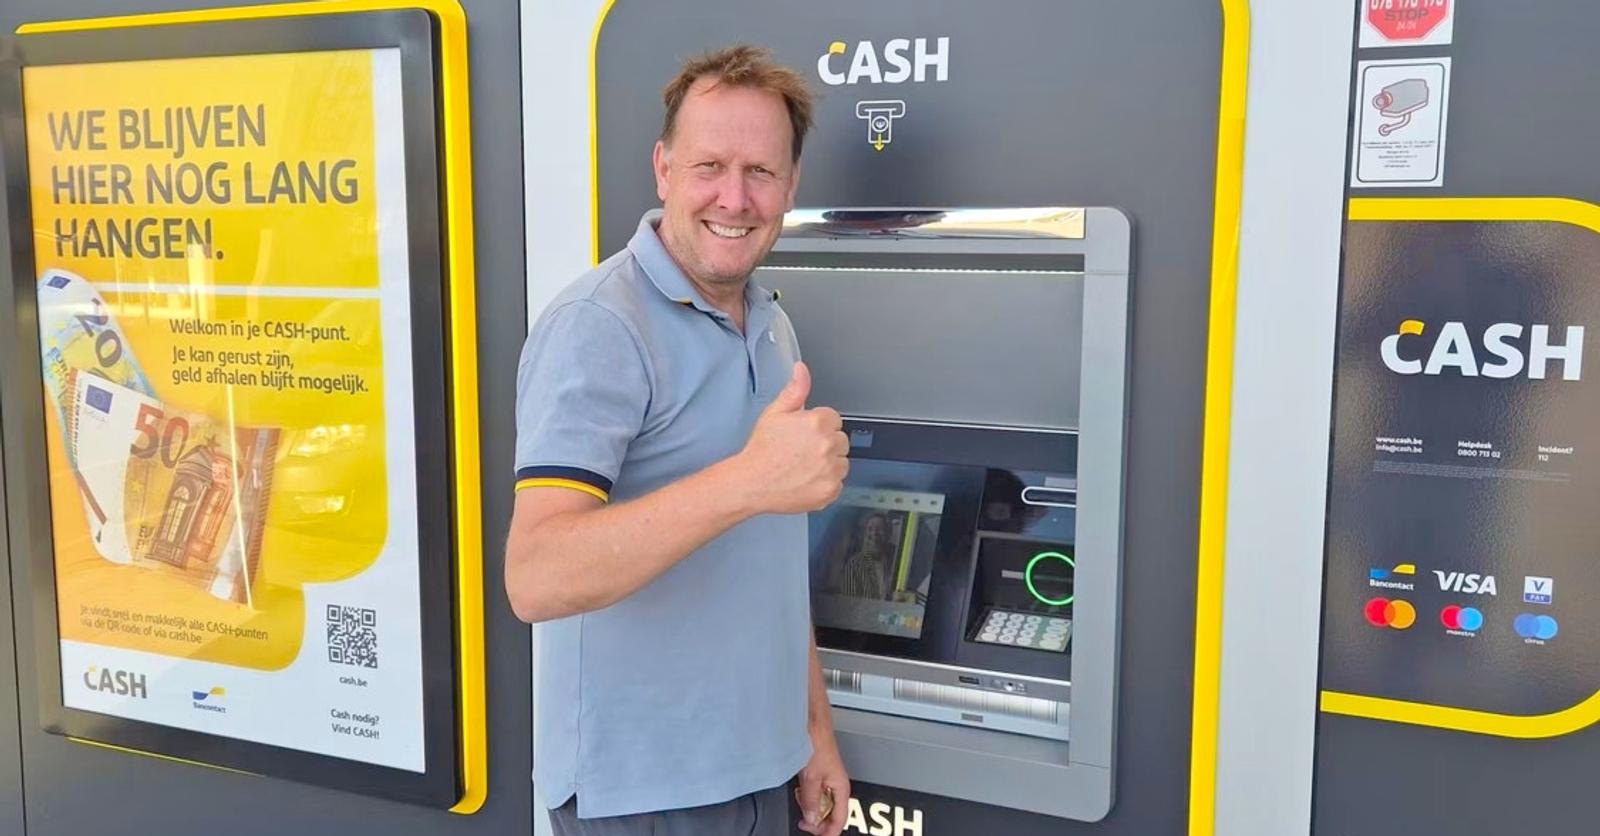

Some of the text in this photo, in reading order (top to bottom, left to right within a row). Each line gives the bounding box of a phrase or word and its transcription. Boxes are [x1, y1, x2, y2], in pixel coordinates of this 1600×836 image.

[1385, 8, 1429, 20] STOP
[817, 37, 950, 85] CASH
[48, 104, 266, 159] WE BLIJVEN
[52, 159, 359, 205] HIER NOG LANG
[54, 217, 224, 261] HANGEN.
[170, 319, 350, 343] Welkom in je CASH-punt.
[173, 345, 294, 371] Je kan gerust zijn,
[1380, 319, 1585, 381] CASH
[172, 367, 369, 395] geld afhalen blijft mogelijk.
[130, 402, 190, 469] 50
[1375, 437, 1423, 446] www.cash.be
[1458, 441, 1492, 450] Helpdesk
[1375, 444, 1423, 454] info@cash.be
[1458, 449, 1478, 457] 0800
[1538, 445, 1573, 455] Incident?
[1369, 578, 1415, 591] Bancontact
[1432, 570, 1498, 595] VISA
[1533, 580, 1545, 591] V
[90, 606, 111, 618] vindt
[112, 609, 130, 621] snel
[131, 612, 144, 622] en
[145, 613, 187, 630] makkelijk
[189, 618, 205, 631] alle
[206, 621, 269, 641] CASH-punten
[94, 618, 105, 629] de
[107, 619, 120, 632] QR
[121, 623, 142, 636] code
[143, 625, 153, 637] of
[154, 629, 167, 639] via
[168, 629, 202, 644] cash.be
[1446, 629, 1475, 638] maestro
[84, 662, 147, 698] CASH
[339, 676, 369, 688] cash.be
[193, 701, 227, 714] Bancontact
[330, 708, 380, 727] Cash nodig?
[331, 722, 380, 740] Vind CASH!
[843, 797, 924, 836] ASH
